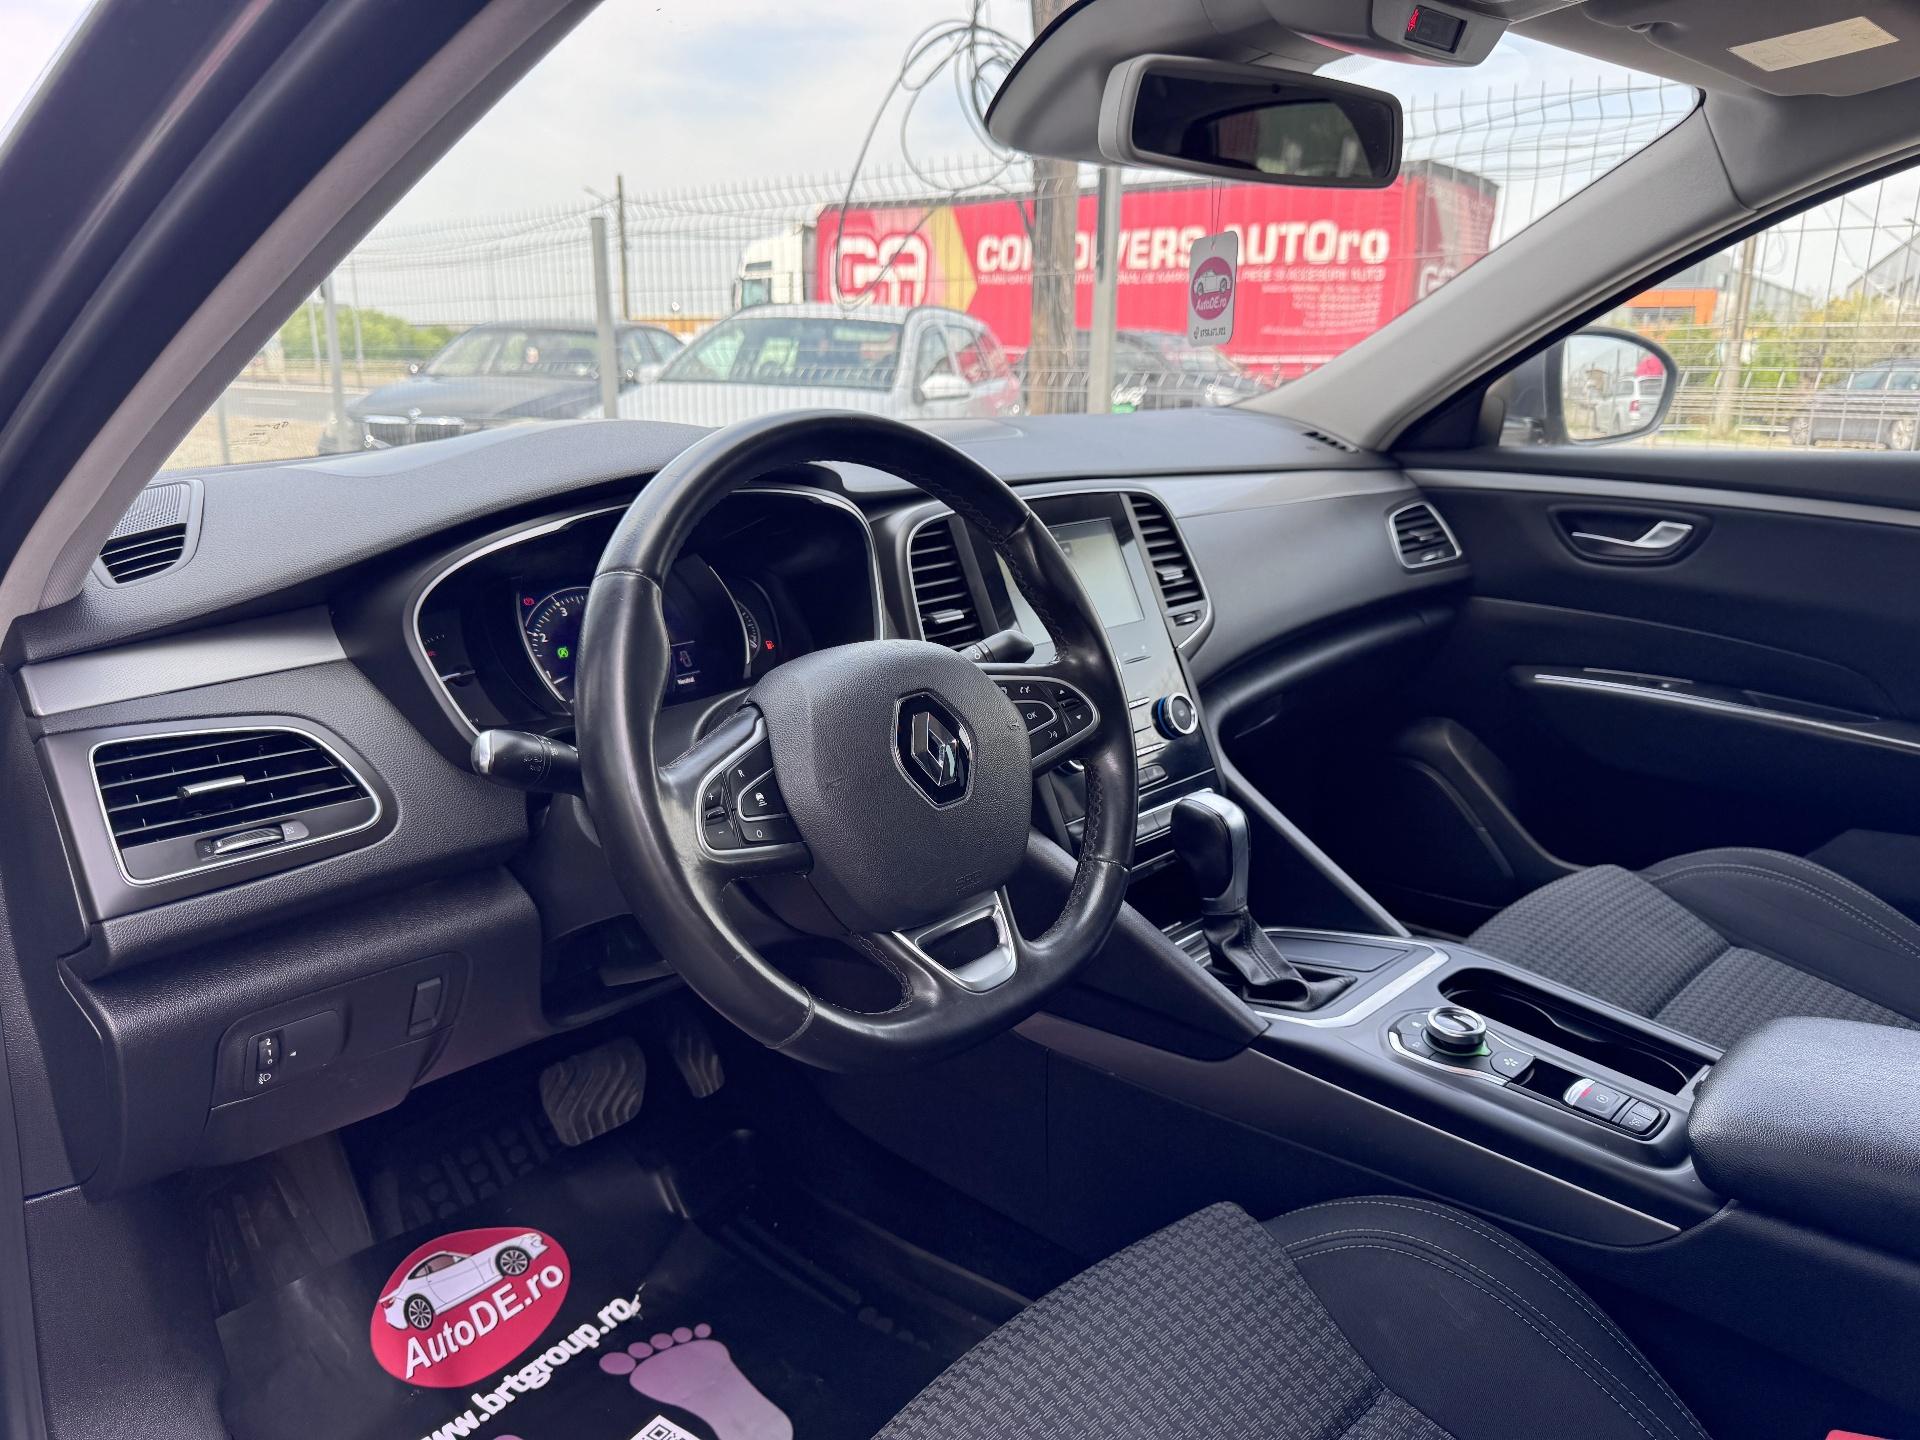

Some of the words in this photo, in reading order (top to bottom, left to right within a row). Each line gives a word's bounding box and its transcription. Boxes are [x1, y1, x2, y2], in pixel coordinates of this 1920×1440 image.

[976, 233, 1033, 273] CO
[560, 607, 568, 617] 3
[540, 633, 549, 643] 2
[1026, 711, 1038, 720] OK
[405, 1263, 565, 1379] AutoDE.ro
